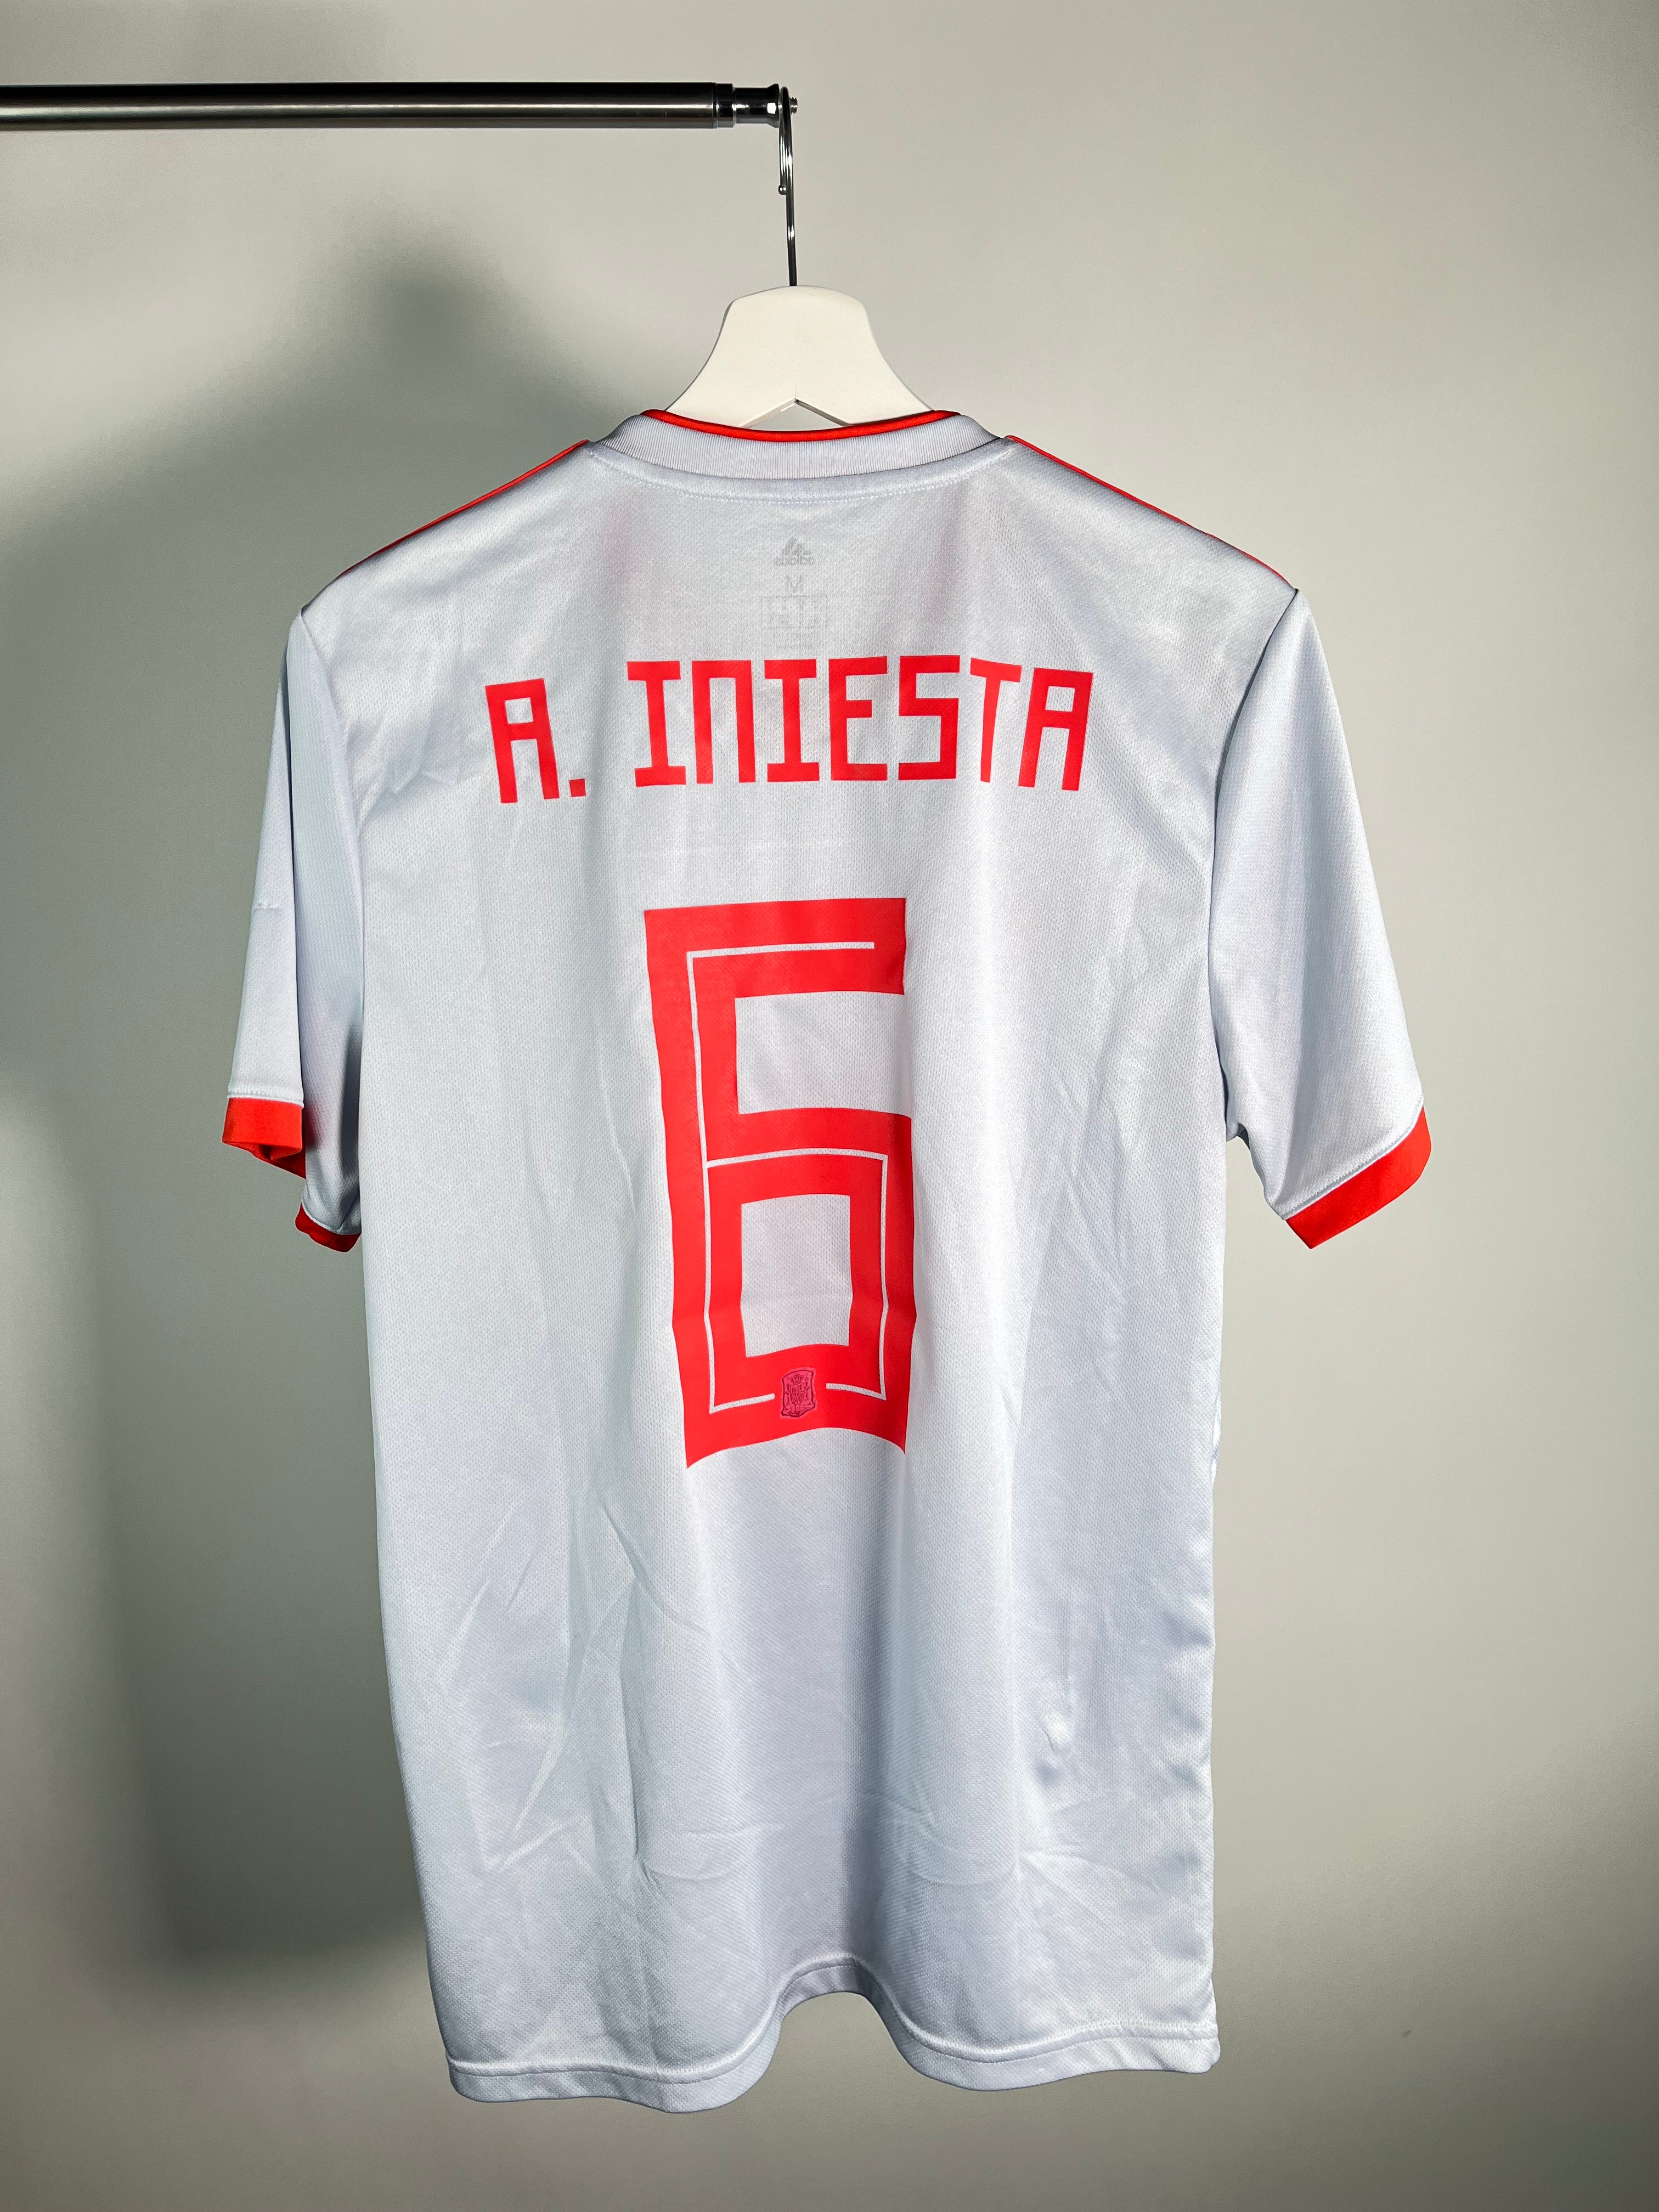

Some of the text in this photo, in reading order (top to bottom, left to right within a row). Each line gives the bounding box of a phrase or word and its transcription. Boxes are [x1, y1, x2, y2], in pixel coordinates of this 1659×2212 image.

[486, 654, 1093, 804] A. INIESTA
[644, 898, 917, 1469] 6
